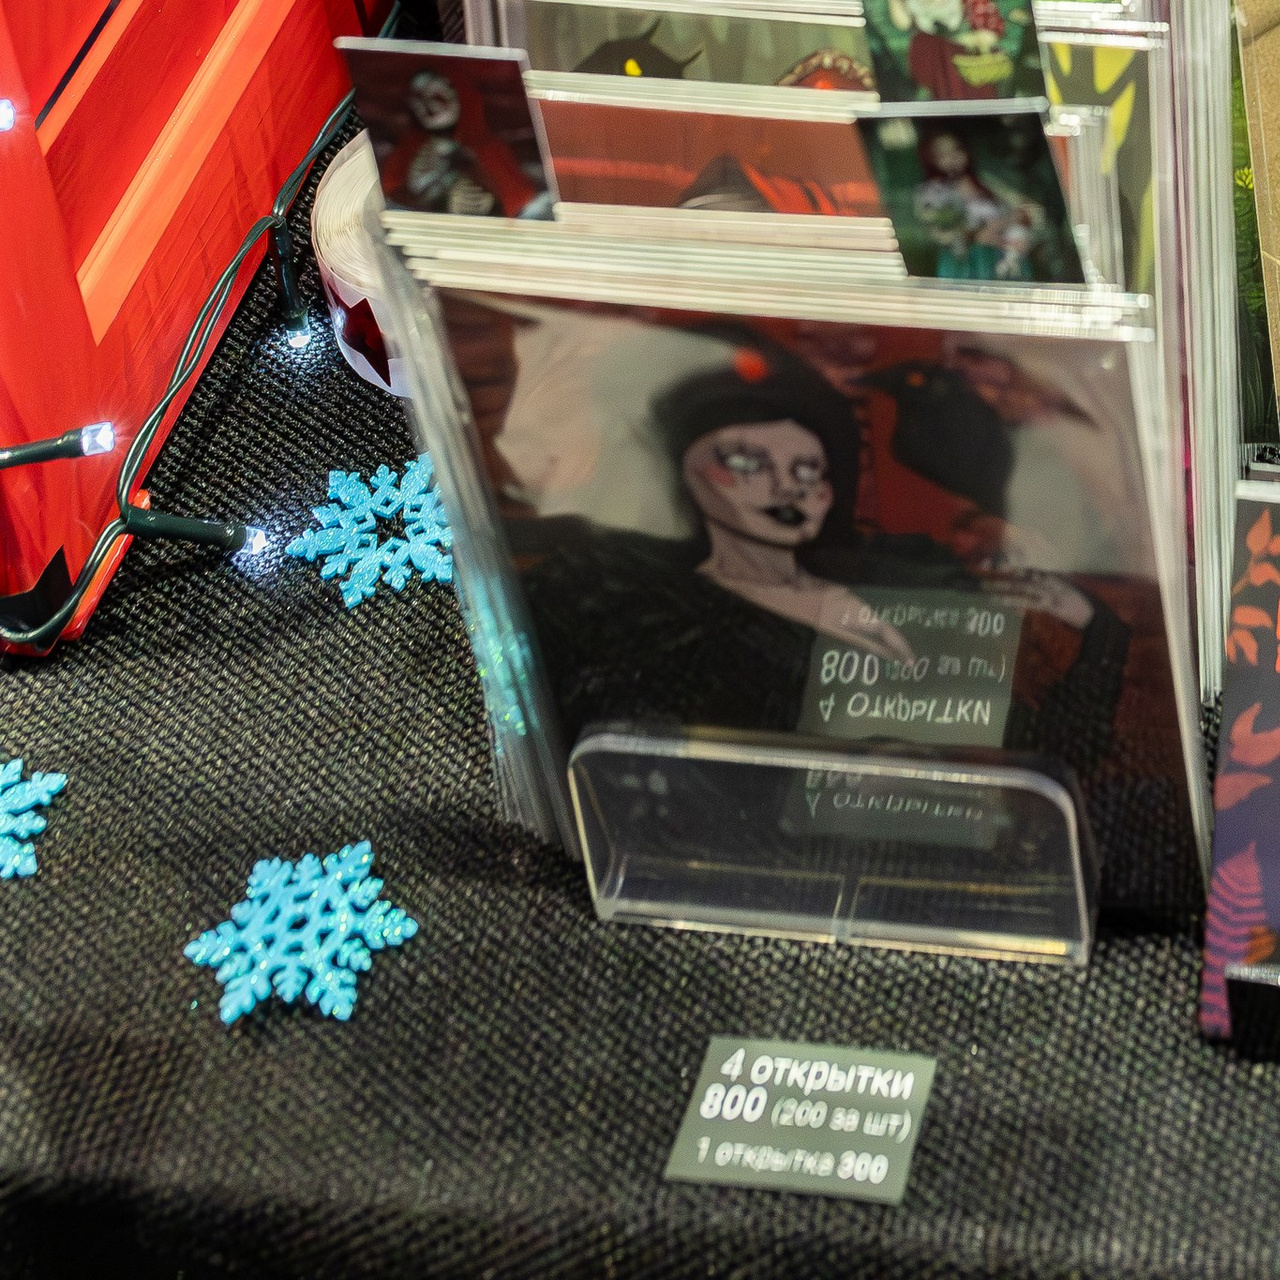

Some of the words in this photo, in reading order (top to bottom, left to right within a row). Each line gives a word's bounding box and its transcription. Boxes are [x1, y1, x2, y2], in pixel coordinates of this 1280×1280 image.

[720, 1047, 746, 1082] 4
[750, 1054, 915, 1101] открытки
[699, 1082, 768, 1123] 800
[771, 1096, 828, 1128] (200
[829, 1107, 860, 1132] за
[696, 1136, 711, 1164] 1
[836, 1150, 890, 1185] 300
